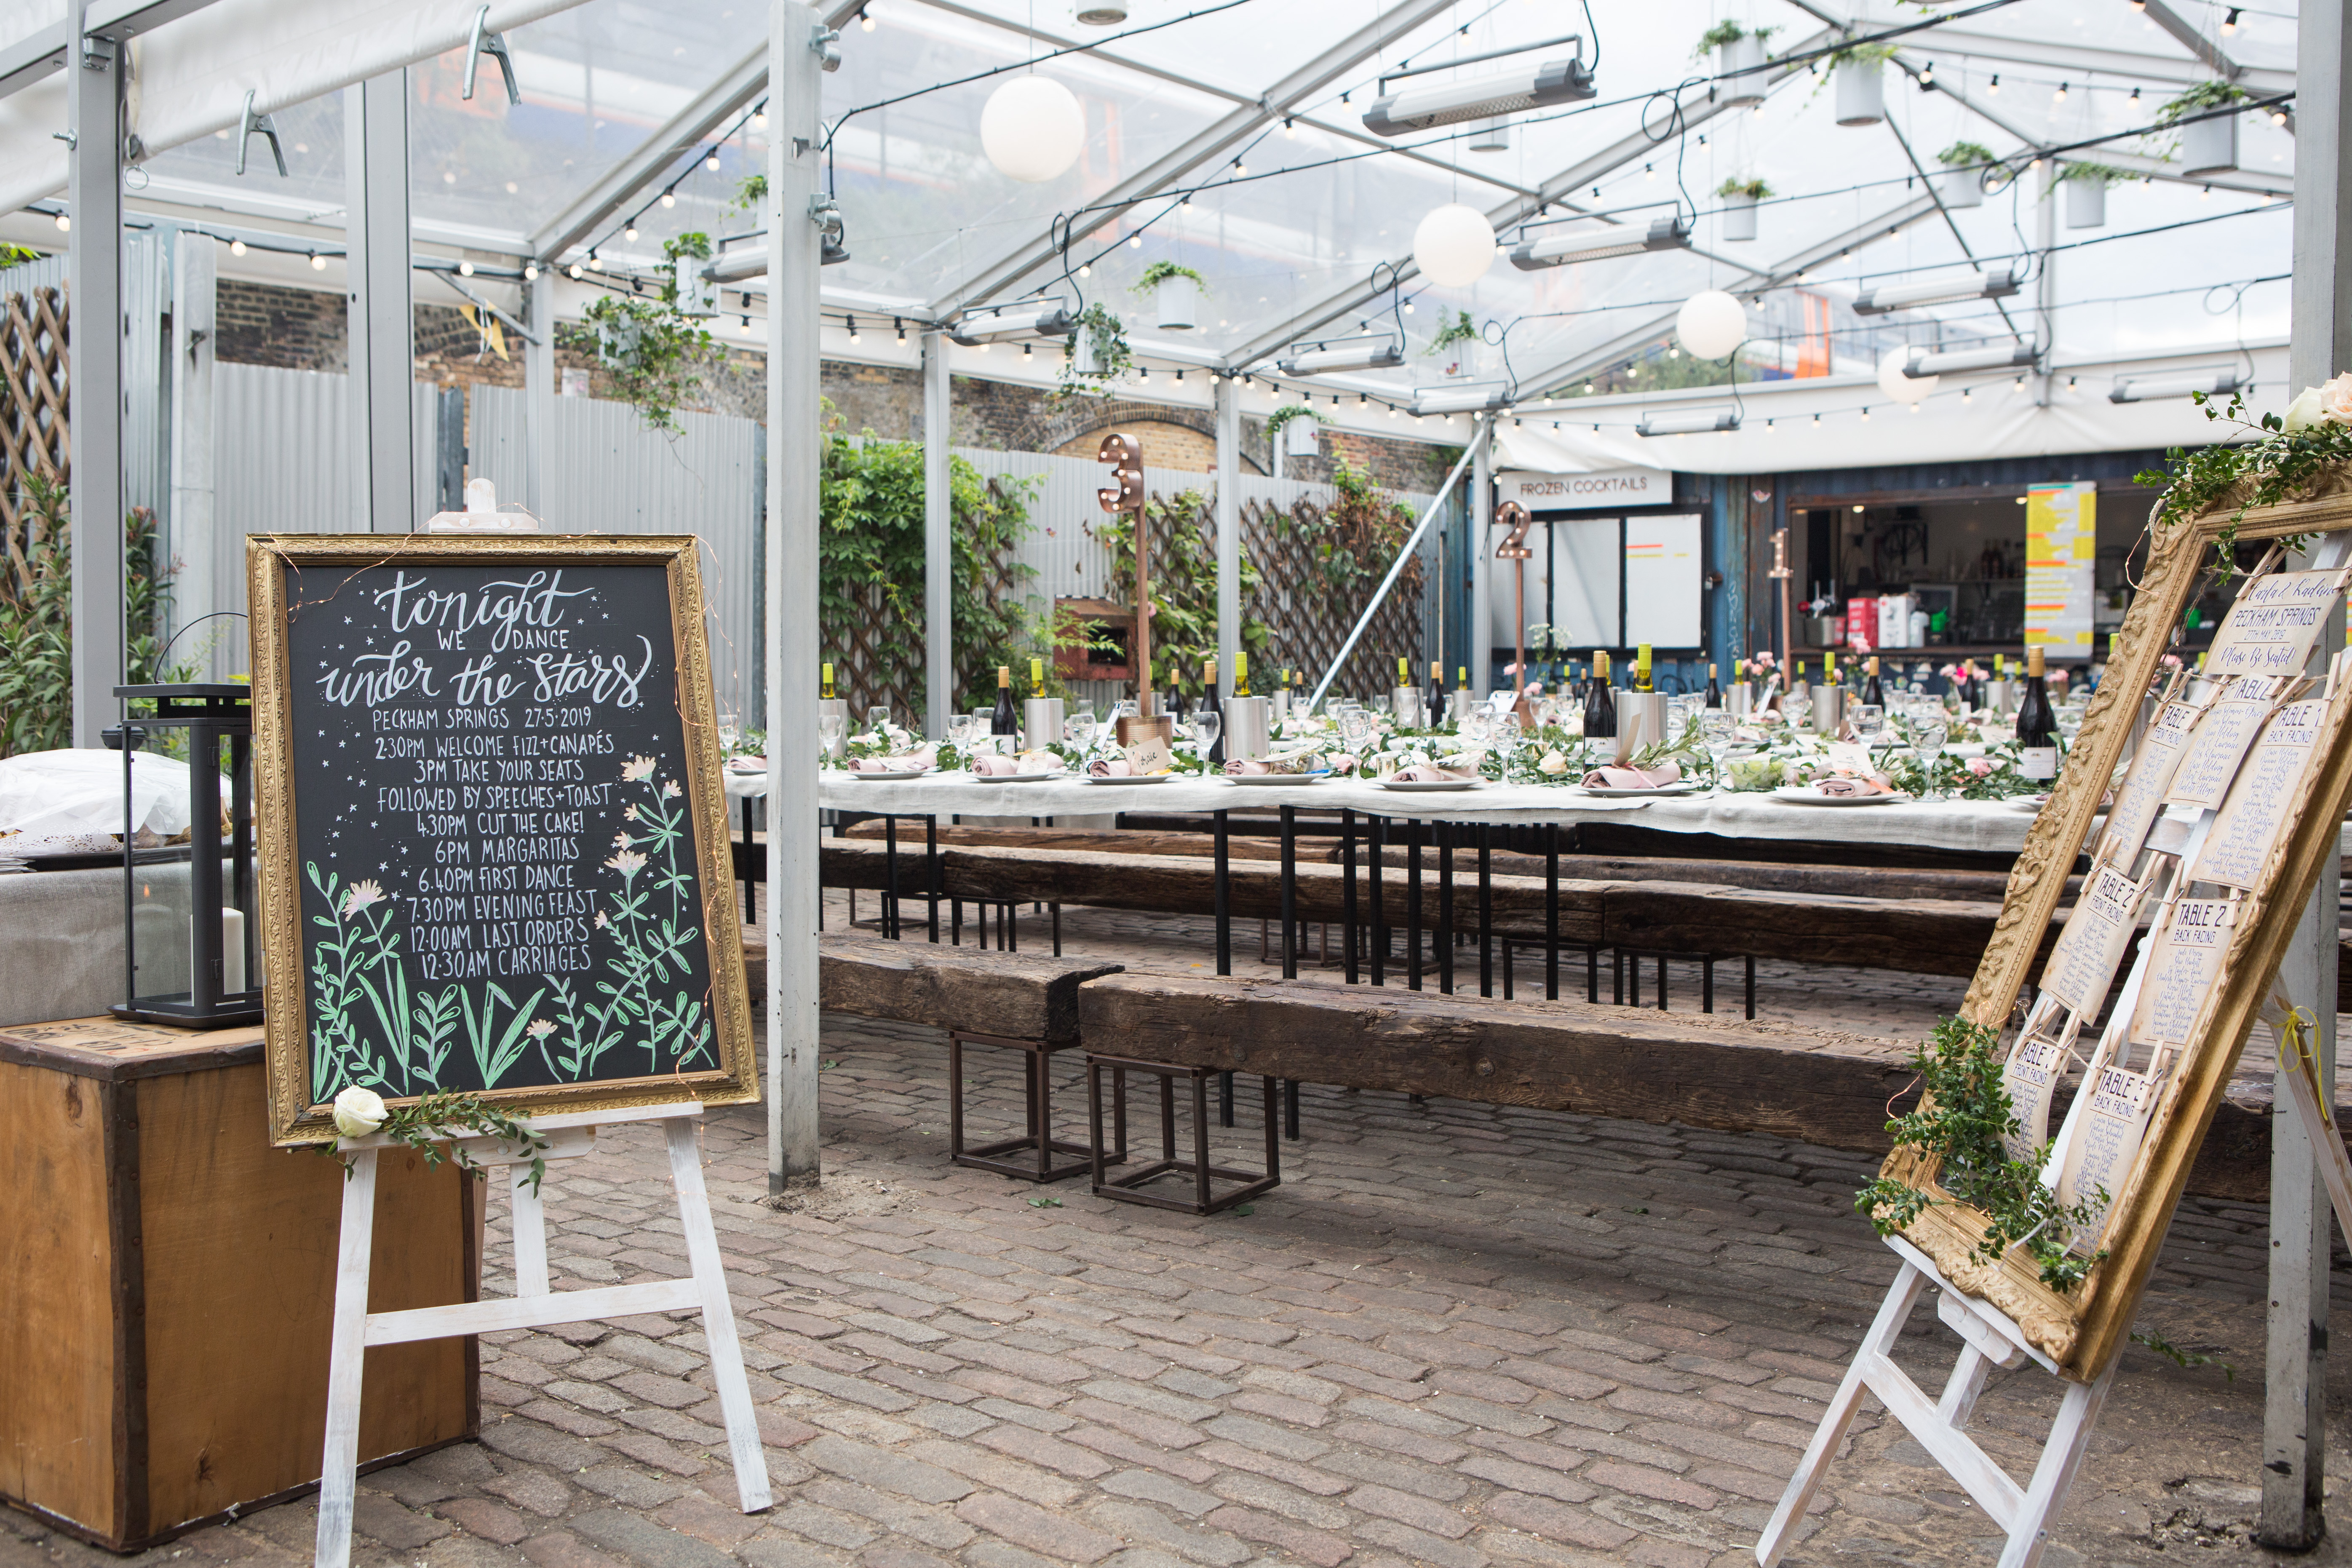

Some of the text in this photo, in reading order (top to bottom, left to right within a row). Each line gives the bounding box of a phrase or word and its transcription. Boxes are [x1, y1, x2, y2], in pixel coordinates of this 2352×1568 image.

[1521, 476, 1647, 495] FROZEN COCKTAILS
[1496, 499, 1532, 559] 2
[2248, 580, 2278, 603] Carla
[374, 569, 595, 653] tonight
[2230, 607, 2321, 627] PECKHAM SPRINGS
[438, 629, 569, 651] WE DANCE
[2244, 630, 2286, 640] 27TH MAY 2019
[2218, 646, 2246, 667] Please
[449, 654, 527, 705] the
[2234, 678, 2272, 701] TABLE
[373, 708, 438, 731] PECKHAM
[445, 707, 510, 729] SPRINGS
[2161, 705, 2190, 729] TABLE
[2275, 705, 2312, 727] TABLE
[436, 735, 504, 757] WELCOME
[2153, 727, 2183, 745] FRONT FACING
[2267, 730, 2313, 743] BACK FACING
[414, 759, 584, 783] 3PM TAKE YOUR SEATS
[377, 786, 456, 812] FOLLOWED
[464, 786, 481, 809] BY
[417, 810, 584, 837] 4.30PM CUT THE CAKE!
[435, 836, 580, 863] 6PM MARGARITAS
[419, 864, 575, 893] 6.40PM FIRST DANCE
[2098, 873, 2135, 908] TABLE 2
[406, 889, 597, 923] 7.30PM EVENING FEAST
[2090, 895, 2123, 922] FRONT FACING
[2178, 904, 2227, 927] TABLE 2
[484, 922, 519, 949] LAST
[526, 917, 589, 947] ORDERS
[2174, 930, 2216, 943] BACK FACING
[499, 944, 591, 975] CARRIAGES
[2019, 1042, 2047, 1066] ABLE
[2013, 1063, 2047, 1084] FRONT FACING
[2099, 1069, 2135, 1098] TABLE
[2094, 1095, 2135, 1117] BACK FACING
